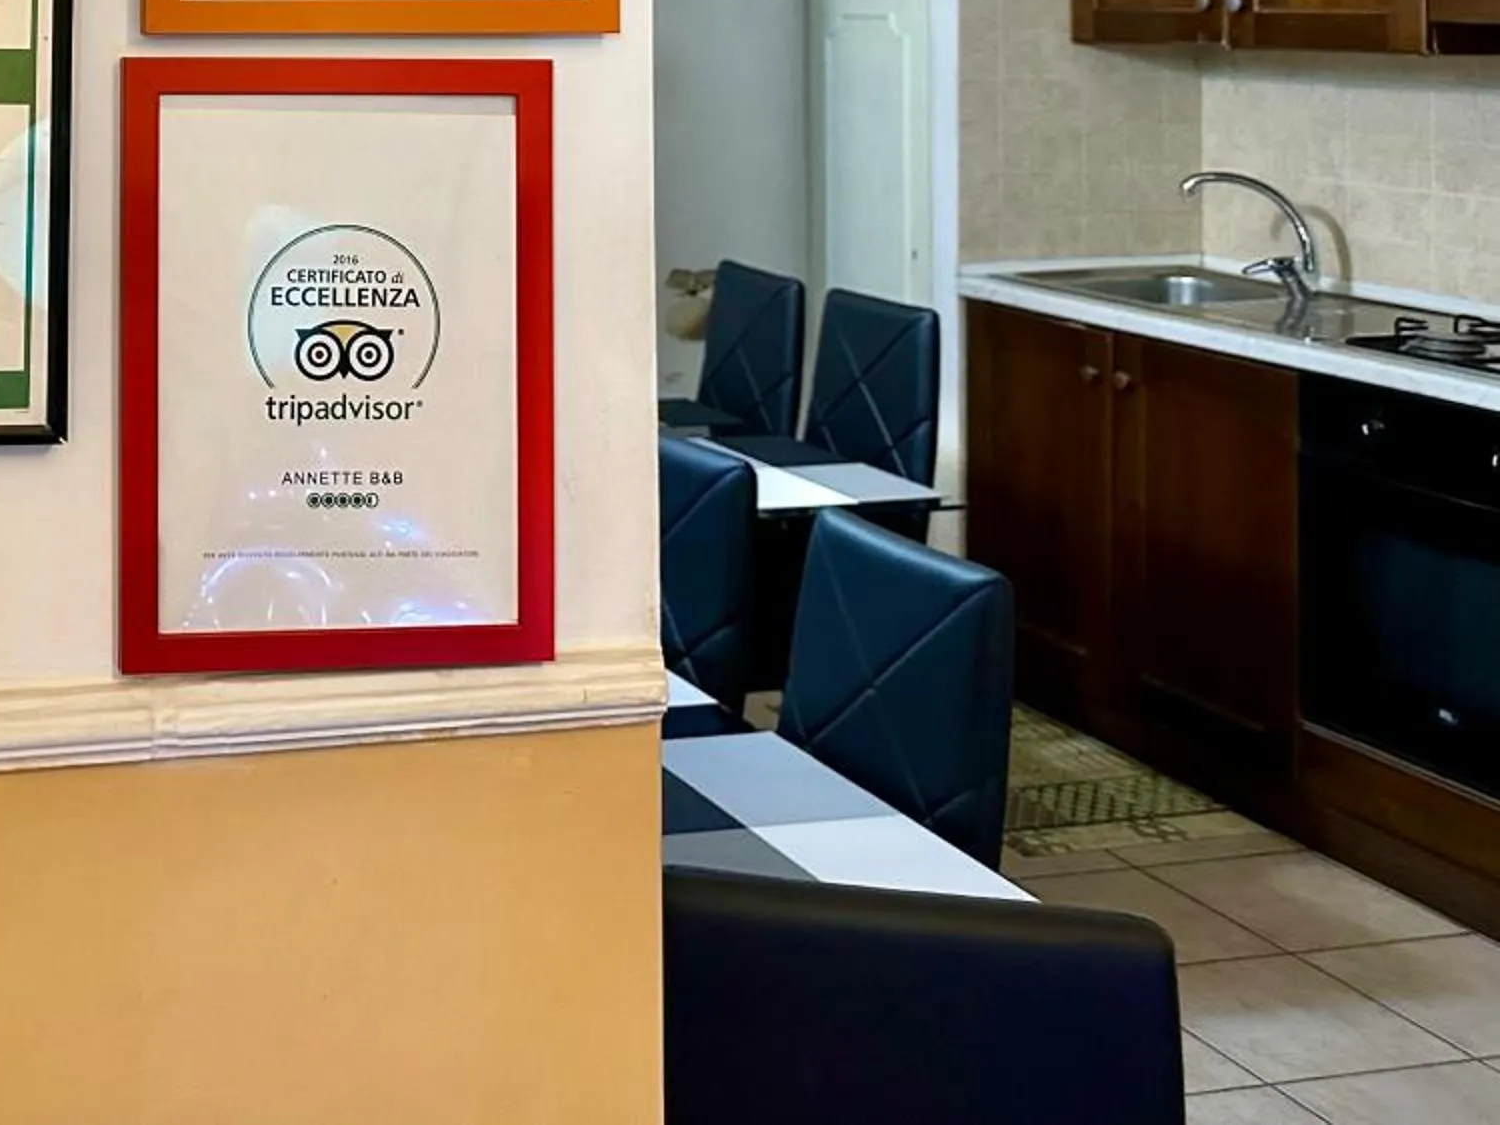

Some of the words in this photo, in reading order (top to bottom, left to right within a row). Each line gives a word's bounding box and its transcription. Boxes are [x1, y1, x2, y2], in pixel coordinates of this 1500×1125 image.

[332, 255, 359, 265] 2016
[287, 269, 387, 284] CERTIFICATO
[270, 287, 421, 307] ECCELLENZA
[265, 394, 414, 427] tripadvisor
[281, 472, 363, 485] ANNETTE
[369, 472, 404, 485] B&B
